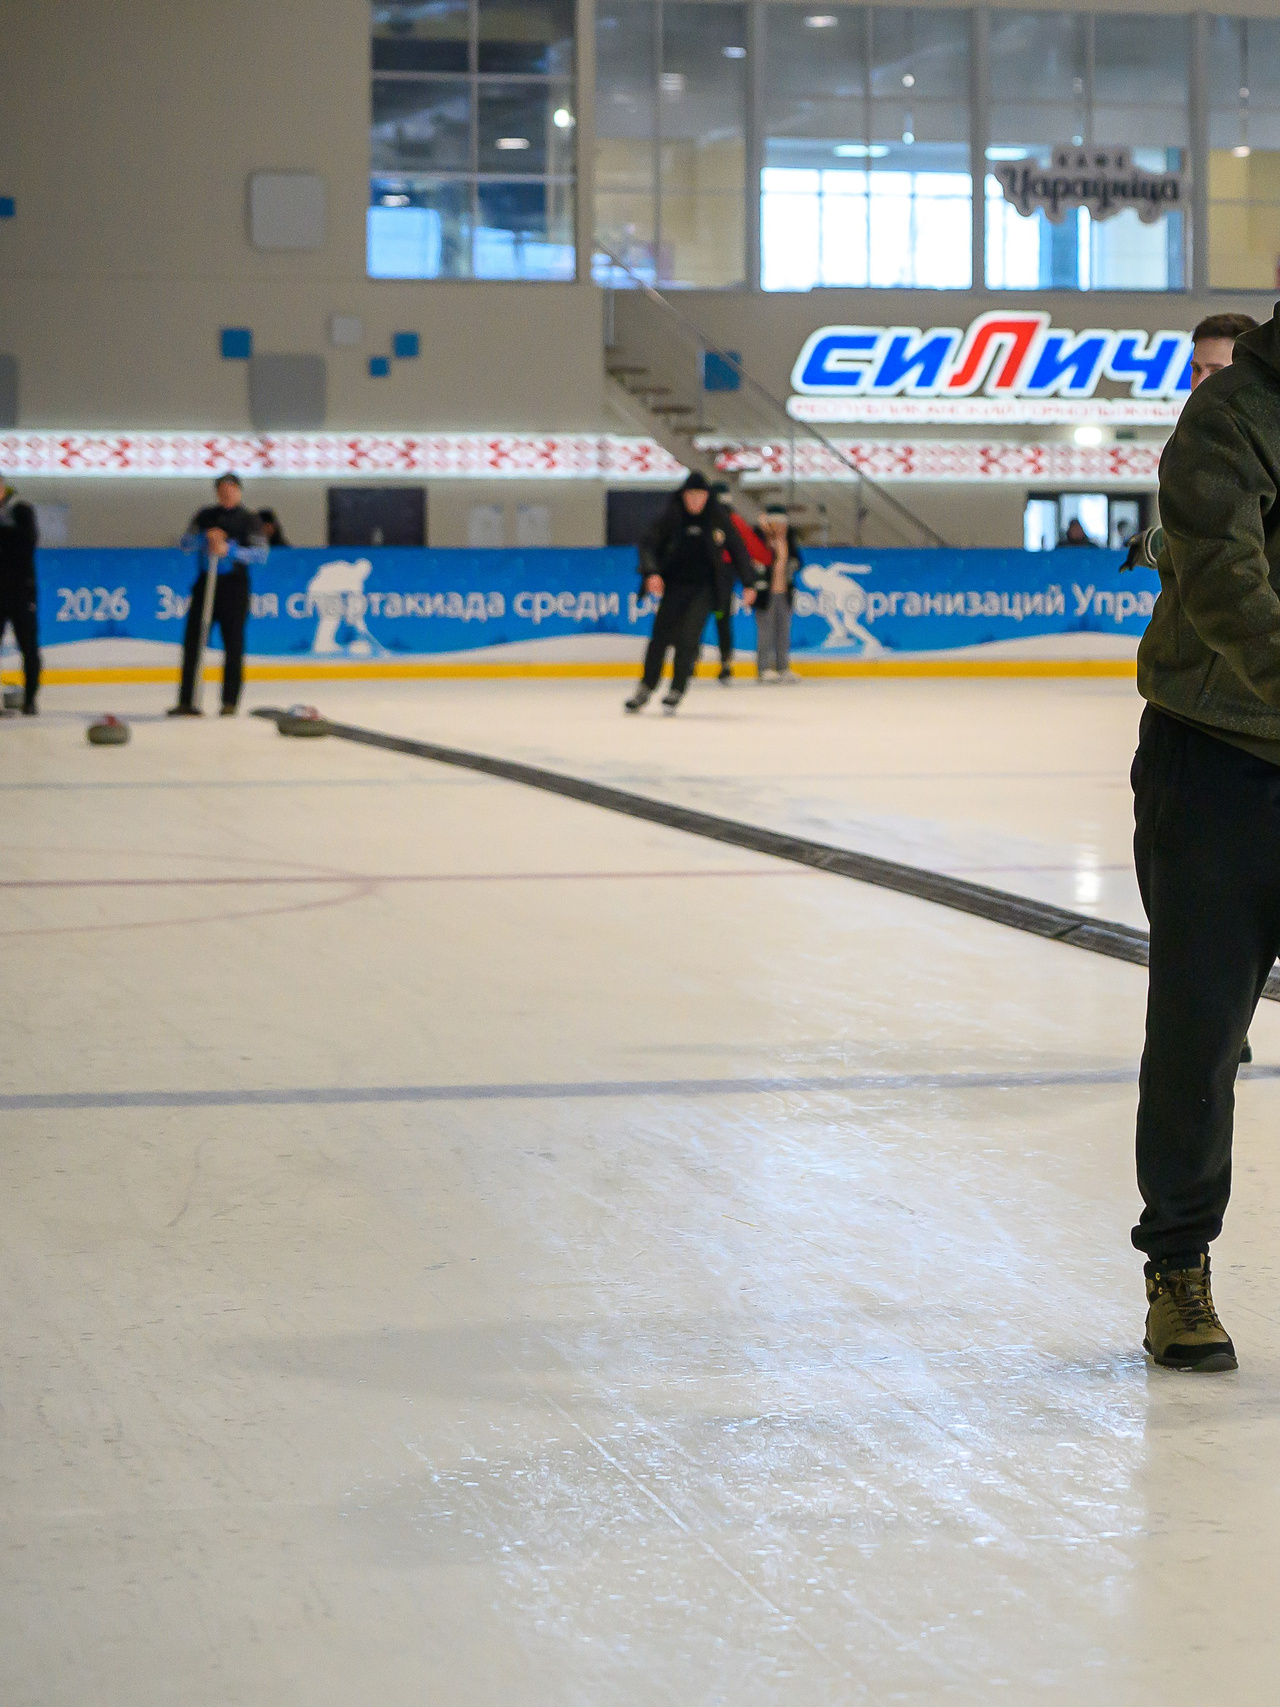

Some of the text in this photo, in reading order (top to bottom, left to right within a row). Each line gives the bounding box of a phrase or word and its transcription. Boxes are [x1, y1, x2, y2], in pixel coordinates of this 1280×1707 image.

[56, 586, 131, 622] 2026
[513, 592, 620, 625] среди
[1071, 583, 1162, 624] Упра
